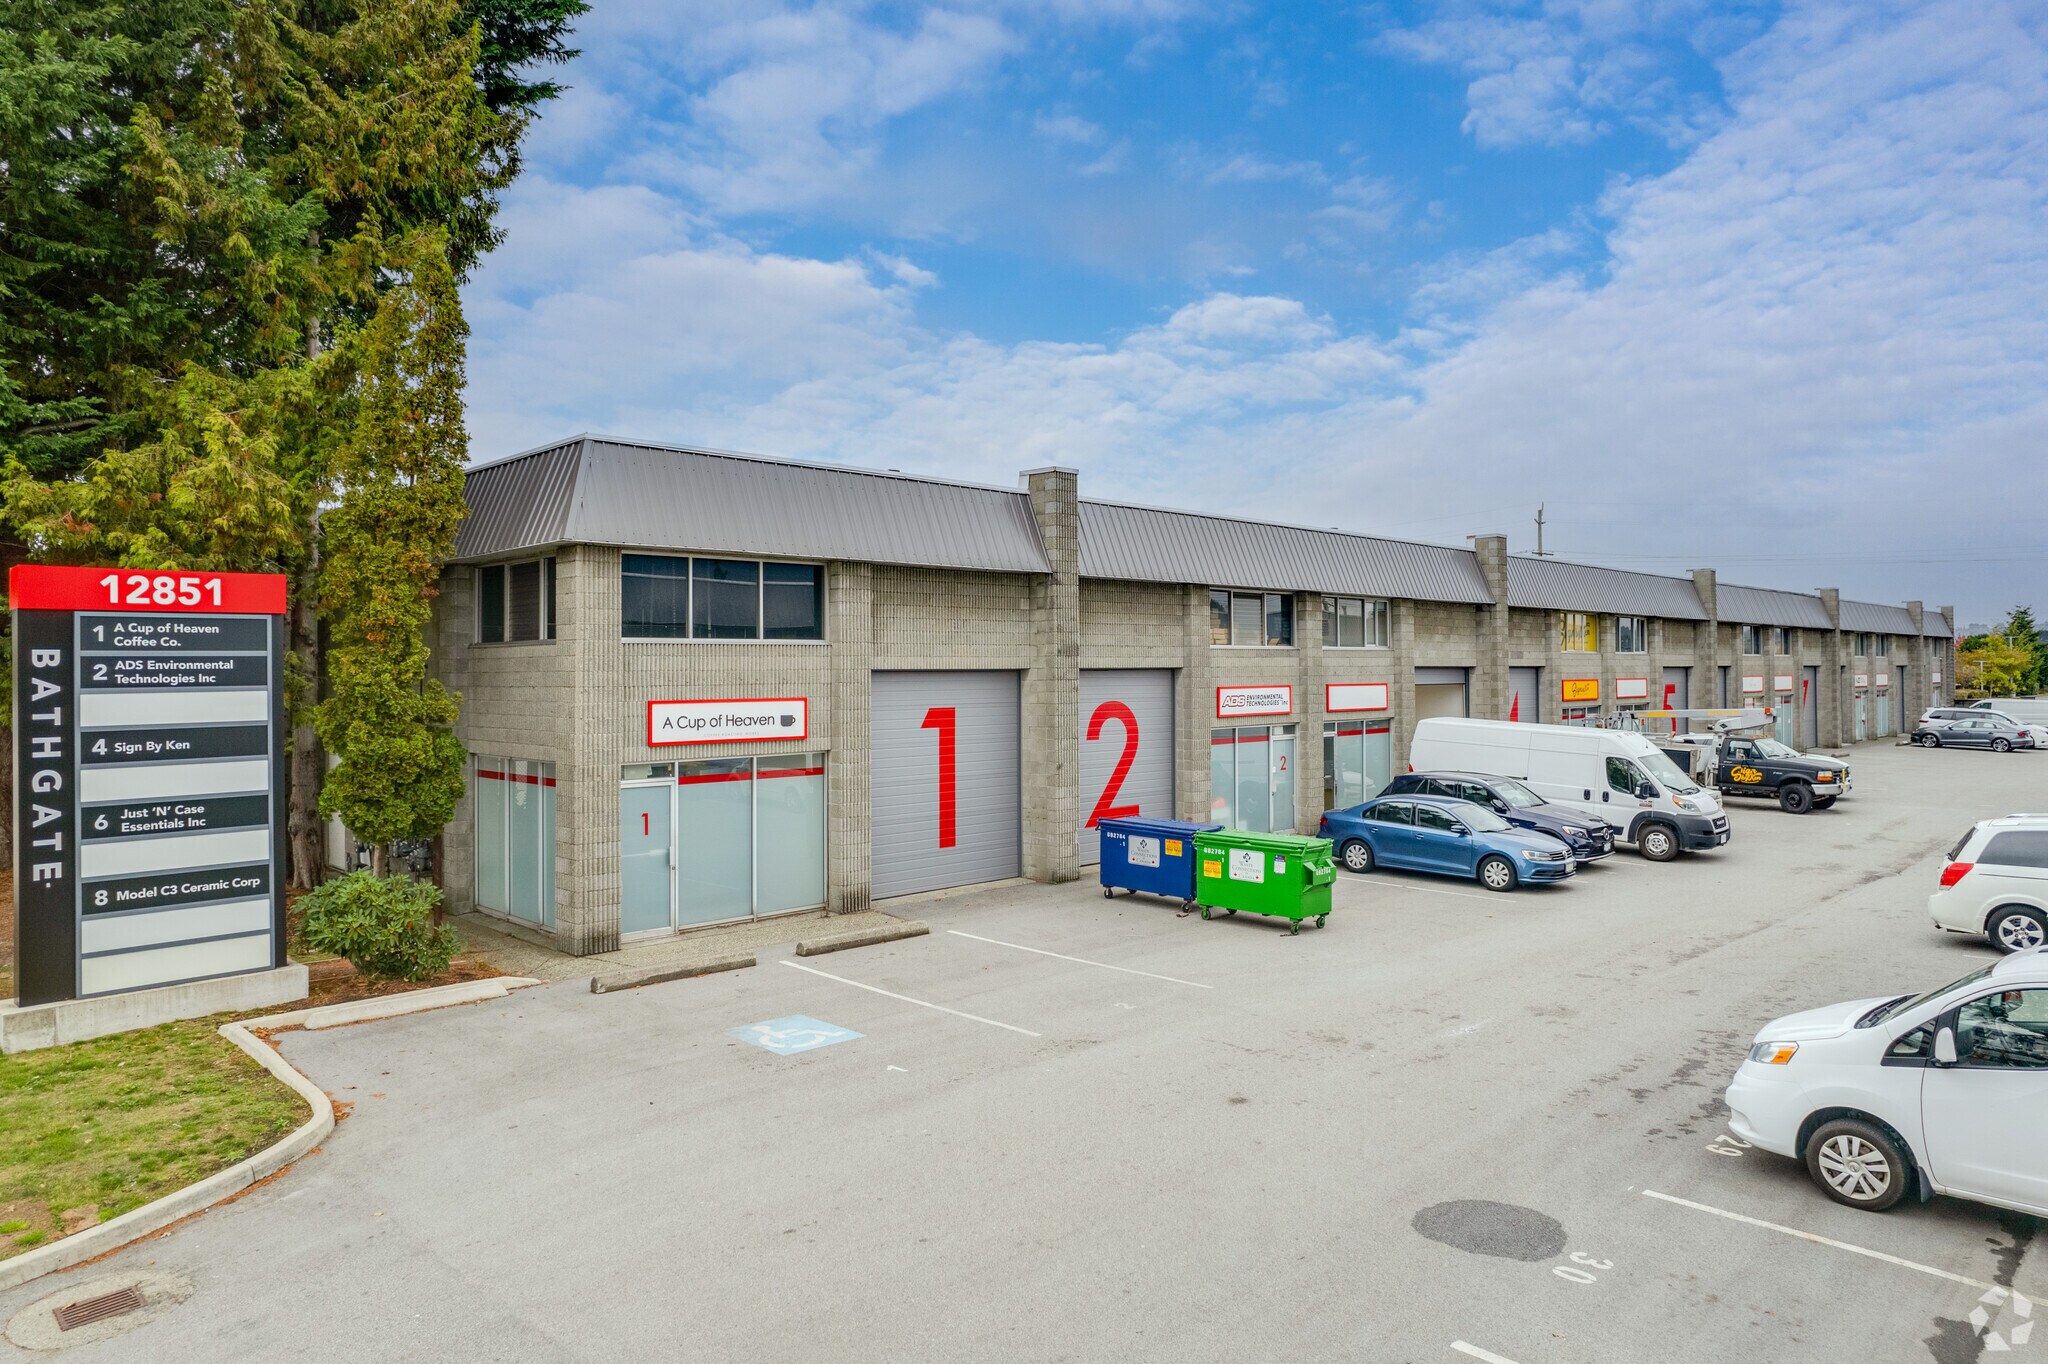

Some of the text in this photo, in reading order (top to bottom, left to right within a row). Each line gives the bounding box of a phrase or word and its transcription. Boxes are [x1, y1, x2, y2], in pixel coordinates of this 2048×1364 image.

[100, 574, 222, 606] 12851
[92, 625, 104, 642] 1
[114, 623, 219, 635] A Cup of Heaven
[114, 636, 181, 647] Coffee Co.
[93, 664, 108, 681] 2
[115, 660, 234, 670] ADS Environmental
[114, 674, 216, 685] Technologies Inc
[1222, 695, 1246, 708] ADS
[663, 714, 775, 731] A Cup of Heaven
[92, 738, 107, 755] 4
[114, 740, 190, 755] Sign By Ken
[1085, 701, 1139, 828] 2
[1280, 755, 1287, 771] 2
[920, 707, 956, 848] 1
[121, 808, 149, 819] Just
[175, 805, 205, 814] Case
[94, 814, 109, 830] 6
[121, 817, 206, 832] Essentials Inc
[641, 813, 648, 835] 1
[94, 889, 109, 906] 8
[116, 877, 261, 901] Model C3 Ceramic Corp
[1705, 1134, 1753, 1157] 29
[1552, 1252, 1614, 1284] 30
